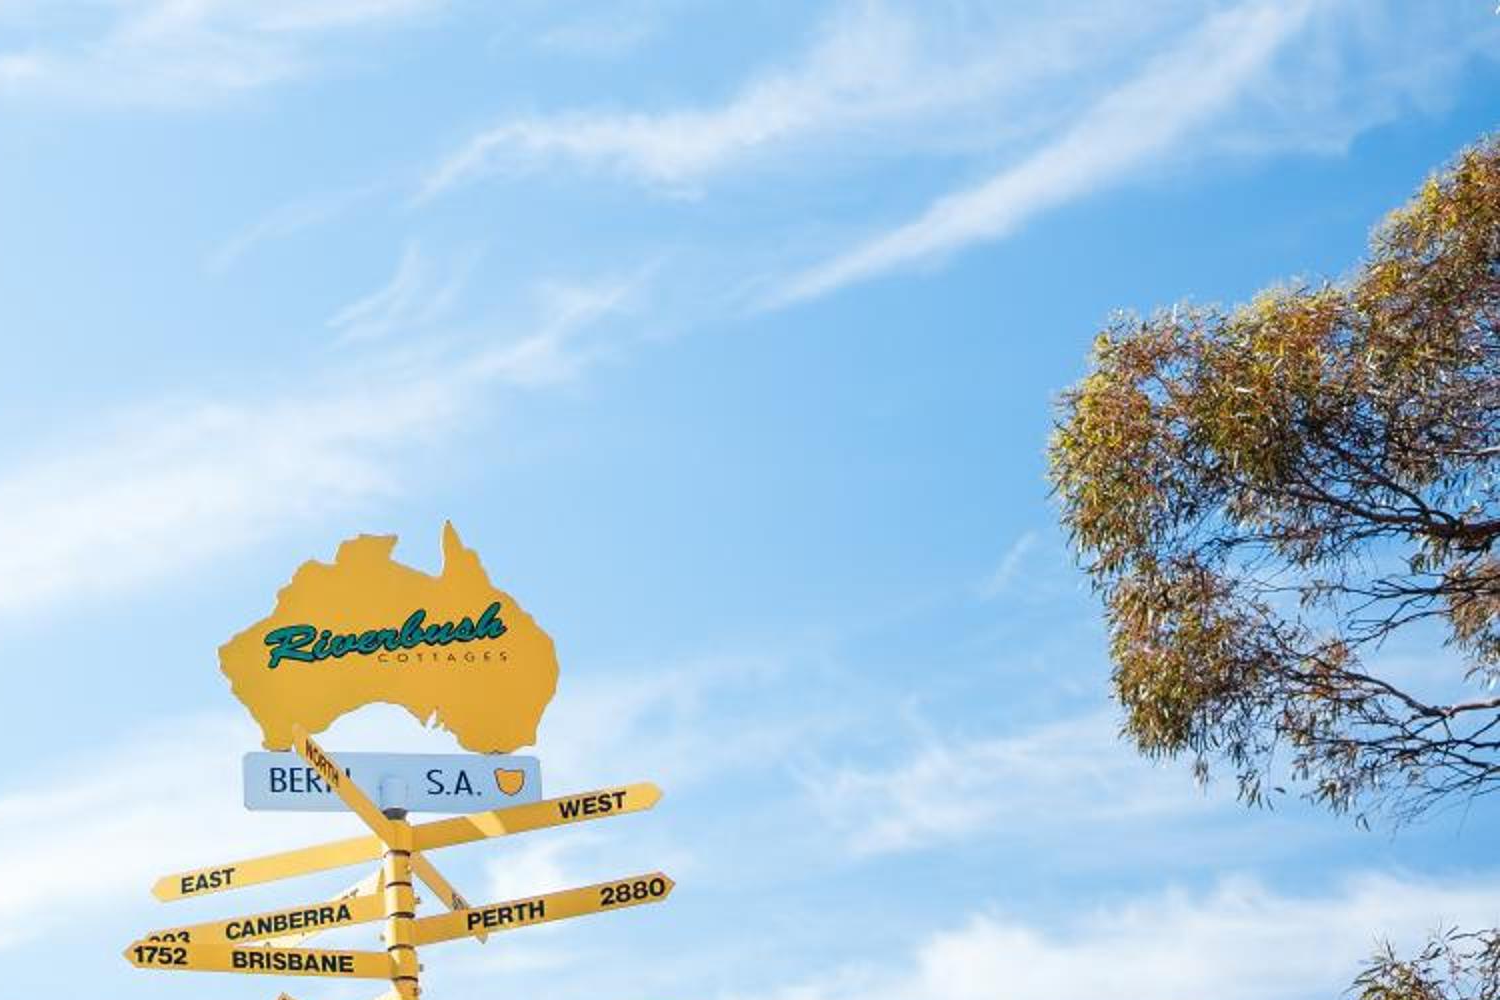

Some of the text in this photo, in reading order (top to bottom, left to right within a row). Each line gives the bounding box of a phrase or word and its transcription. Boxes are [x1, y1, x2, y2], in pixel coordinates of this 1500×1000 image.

[264, 602, 508, 669] Riverbush
[377, 652, 508, 663] COTTAGES
[305, 739, 340, 786] NORTH
[270, 767, 482, 796] BER S.A.
[559, 791, 627, 819] WEST
[181, 868, 235, 895] EAST
[467, 900, 545, 930] PERTH
[600, 878, 665, 906] 2880
[225, 904, 352, 941] CANBERRA
[134, 946, 354, 973] 1752 BRISBANE
